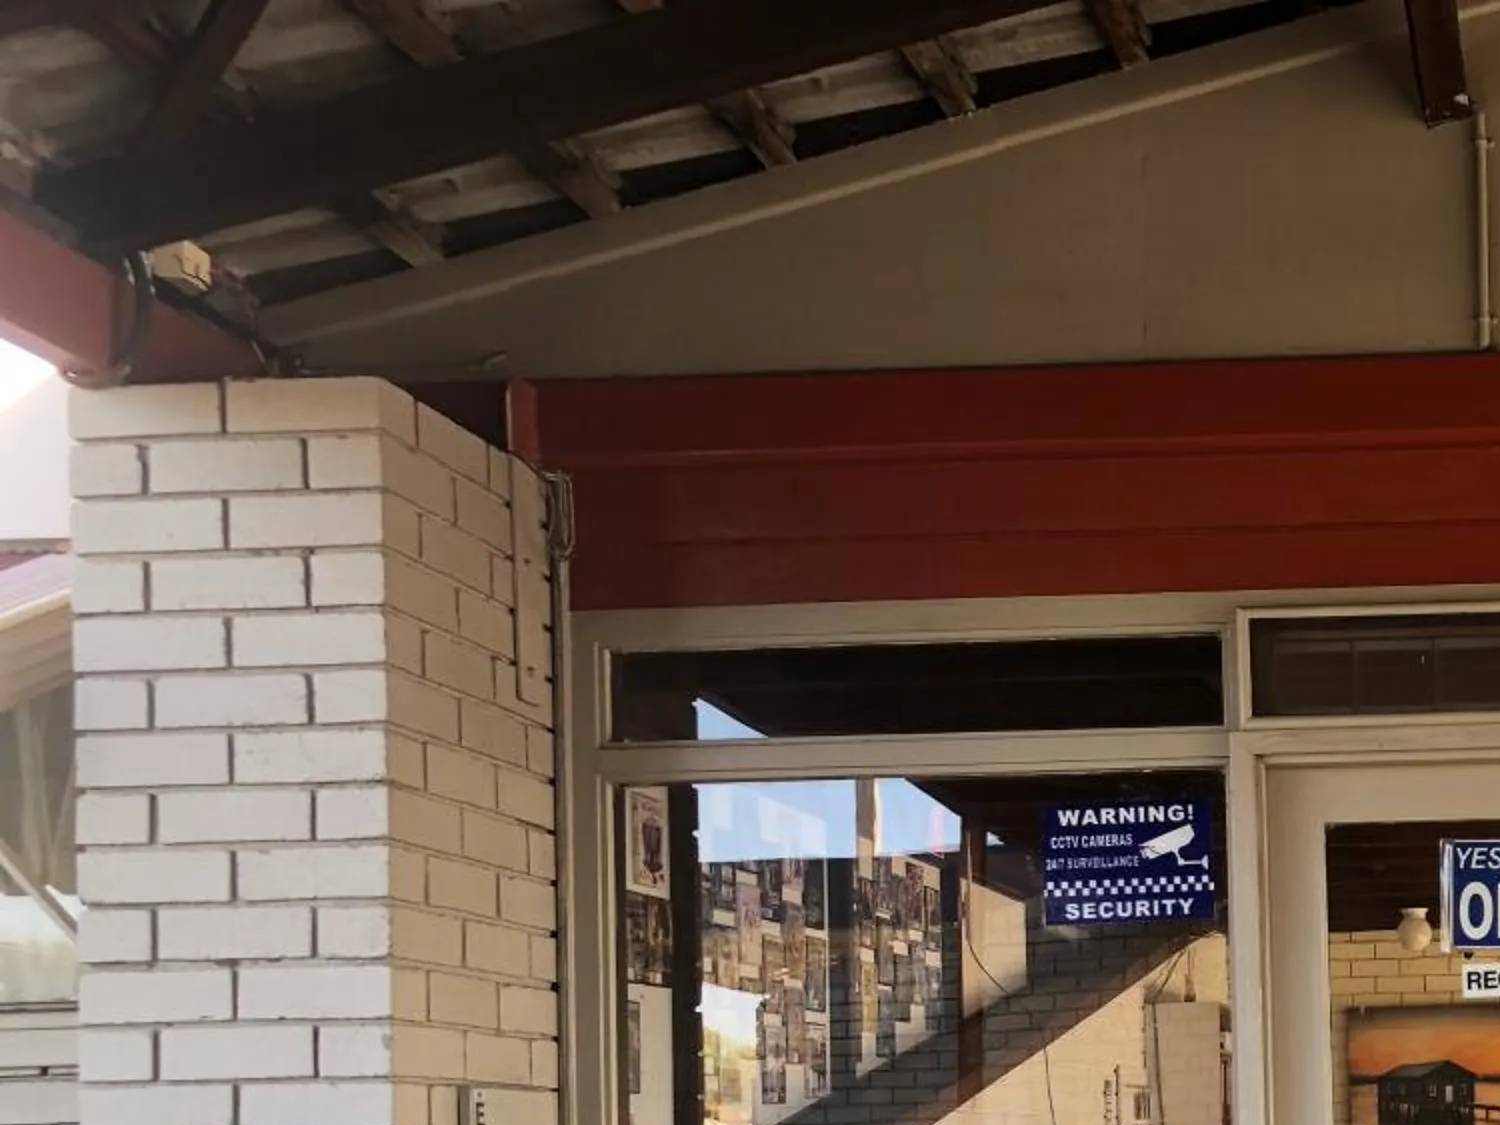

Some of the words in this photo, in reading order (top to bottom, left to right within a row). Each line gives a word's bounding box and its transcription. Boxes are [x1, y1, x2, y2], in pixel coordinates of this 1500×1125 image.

[1057, 804, 1194, 826] WARNING!
[1051, 836, 1079, 849] CCTV
[1081, 833, 1133, 847] CAMERAS
[1067, 856, 1139, 870] SURVEILLANCE
[1065, 898, 1195, 920] SECURITY
